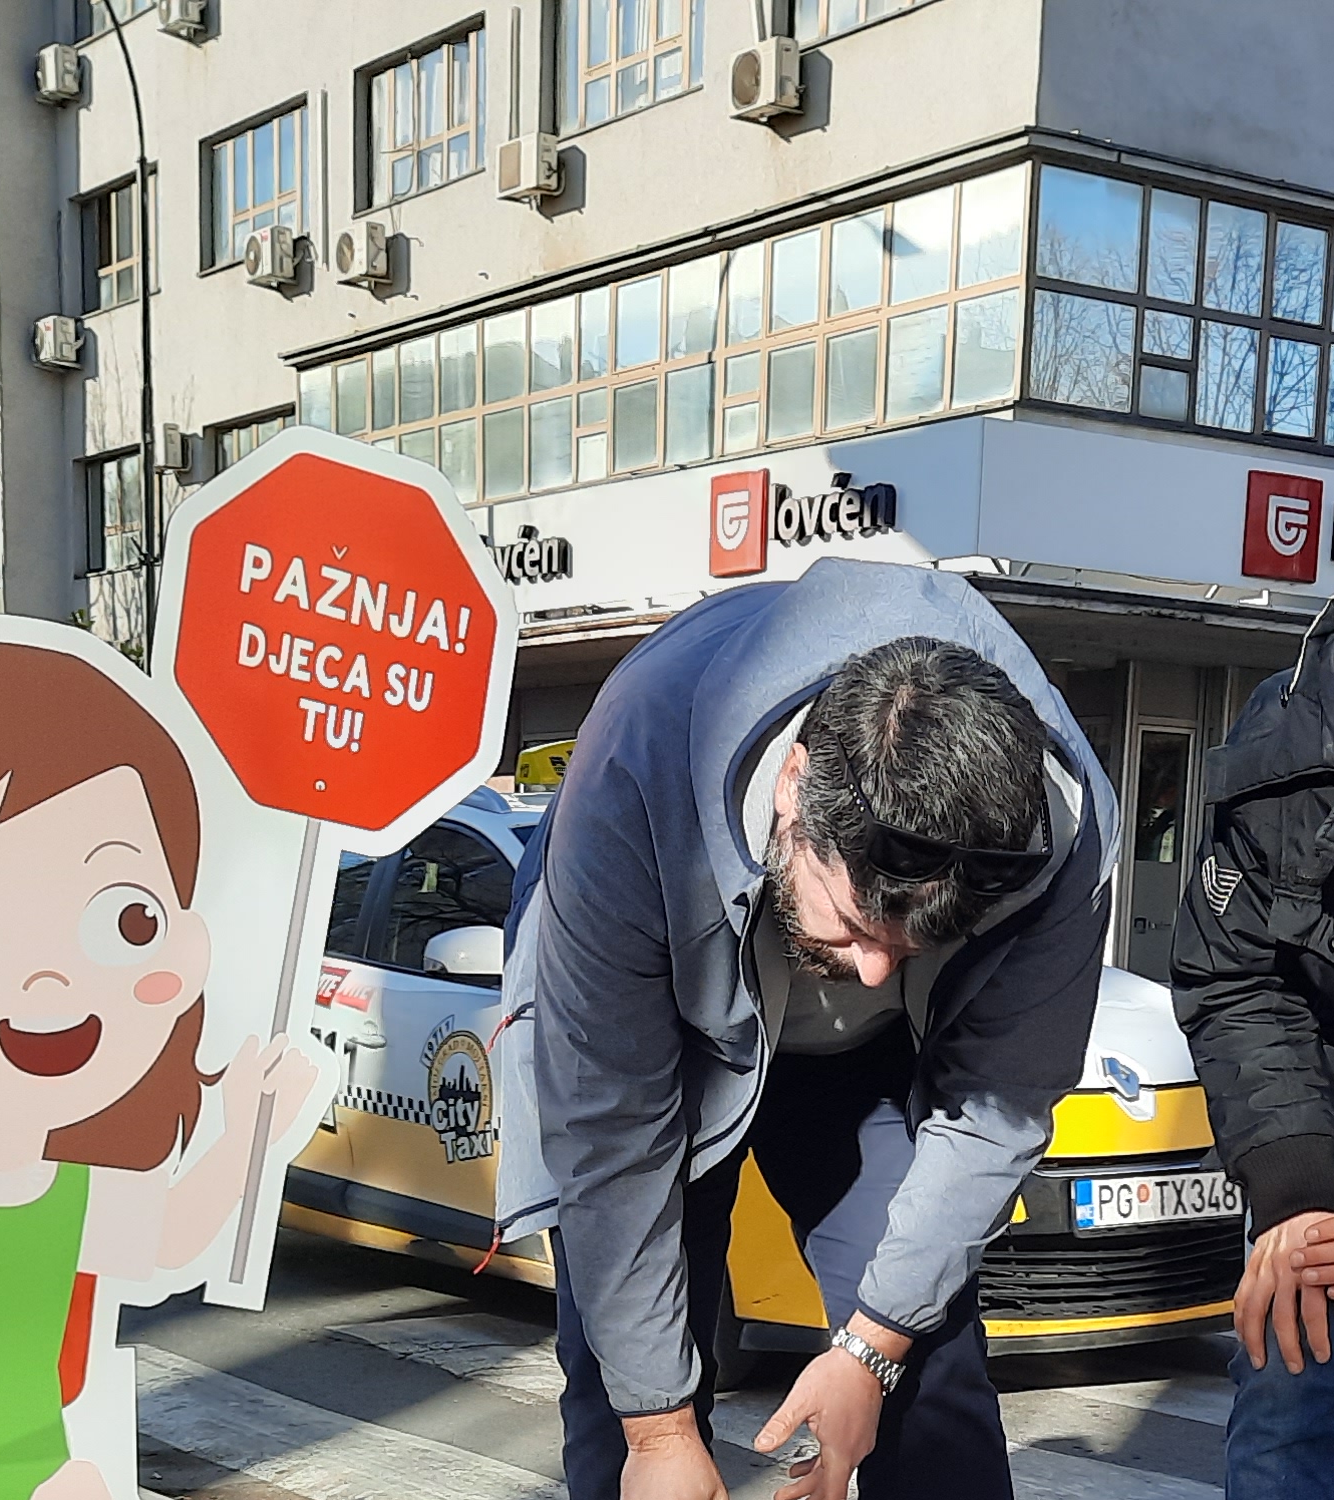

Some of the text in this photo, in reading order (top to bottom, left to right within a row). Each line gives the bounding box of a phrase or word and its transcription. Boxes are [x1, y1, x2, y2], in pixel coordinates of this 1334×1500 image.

[482, 525, 573, 584] vćen
[237, 542, 472, 655] PAŽNJA!
[237, 622, 435, 713] DJECA SU
[297, 697, 365, 754] TU!
[431, 1097, 480, 1133] City
[440, 1120, 494, 1164] Taxi
[1098, 1177, 1238, 1221] PG TX348
